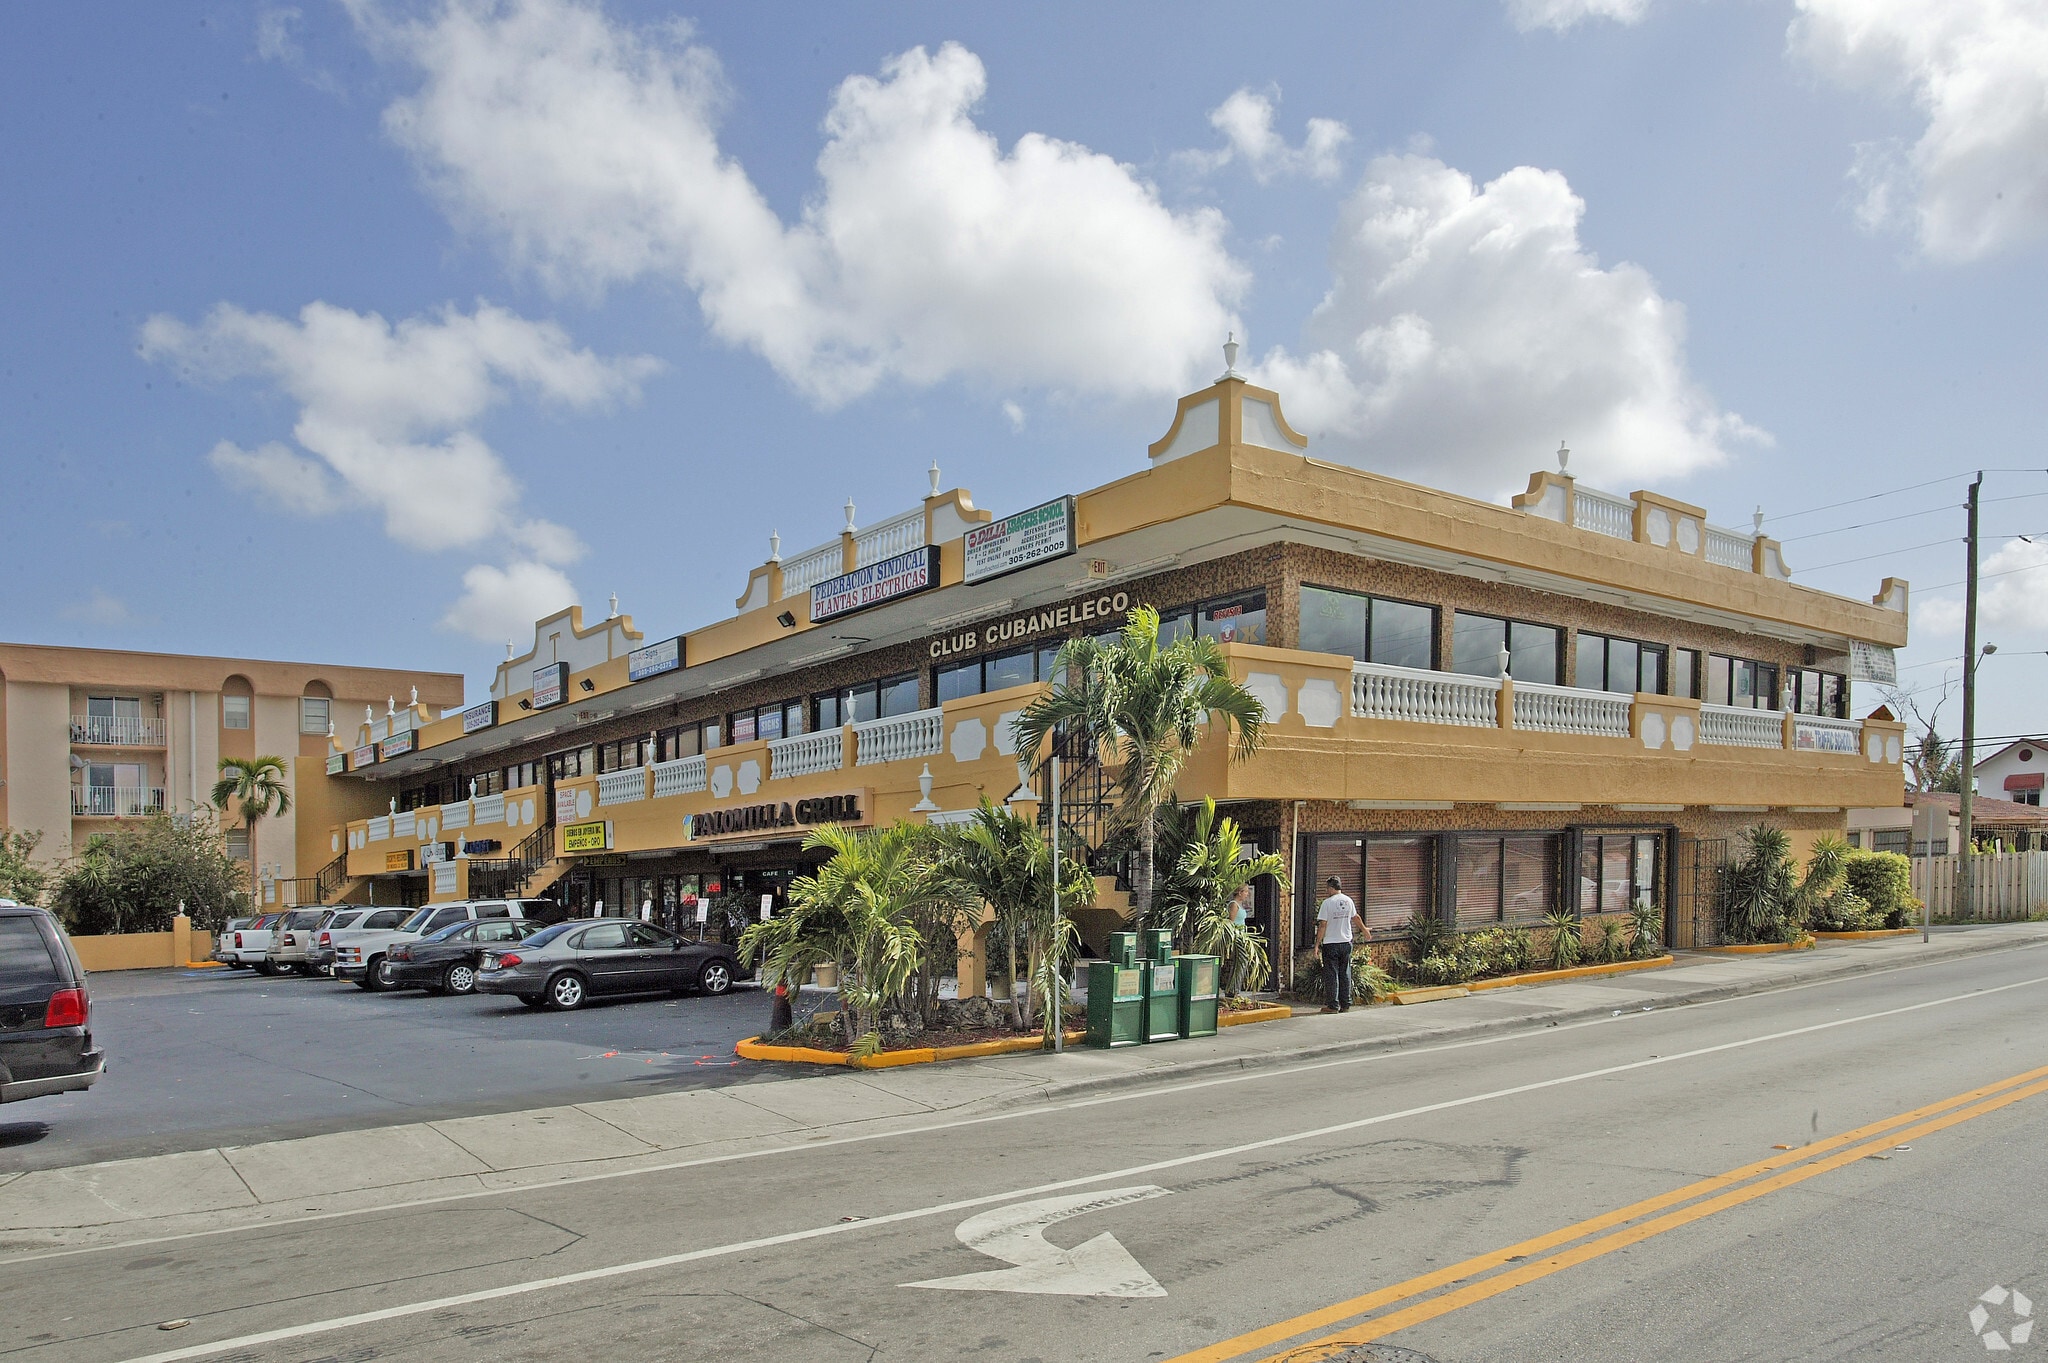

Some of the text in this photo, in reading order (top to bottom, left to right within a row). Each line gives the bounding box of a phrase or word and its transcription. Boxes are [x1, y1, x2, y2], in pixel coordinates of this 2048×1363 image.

[1039, 502, 1064, 524] SCHOOL
[1021, 525, 1066, 544] AGGRESSIVE DRIVING
[1024, 523, 1047, 536] DEFENSIVE
[976, 537, 1052, 566] TEST ONLINE FOR LEARNERS PERMIT
[982, 536, 1011, 550] IMPROVEMENT
[988, 546, 1002, 555] HOURS
[1008, 540, 1065, 565] 305-262-0009
[815, 550, 925, 601] FEDERACION SINDICAL
[1094, 560, 1106, 574] EXIT
[815, 568, 926, 618] PLANTAS ELECTRICAS
[929, 592, 1128, 658] CLUB CUBANELECO
[464, 705, 491, 721] INSURANCE
[761, 718, 780, 732] SIGNS
[1814, 730, 1834, 750] TRAFFIC
[1834, 731, 1853, 751] SCHOOL
[557, 799, 575, 808] AVAILABLE
[560, 790, 572, 798] SPACE
[694, 795, 861, 837] PALOMILLA GRILL
